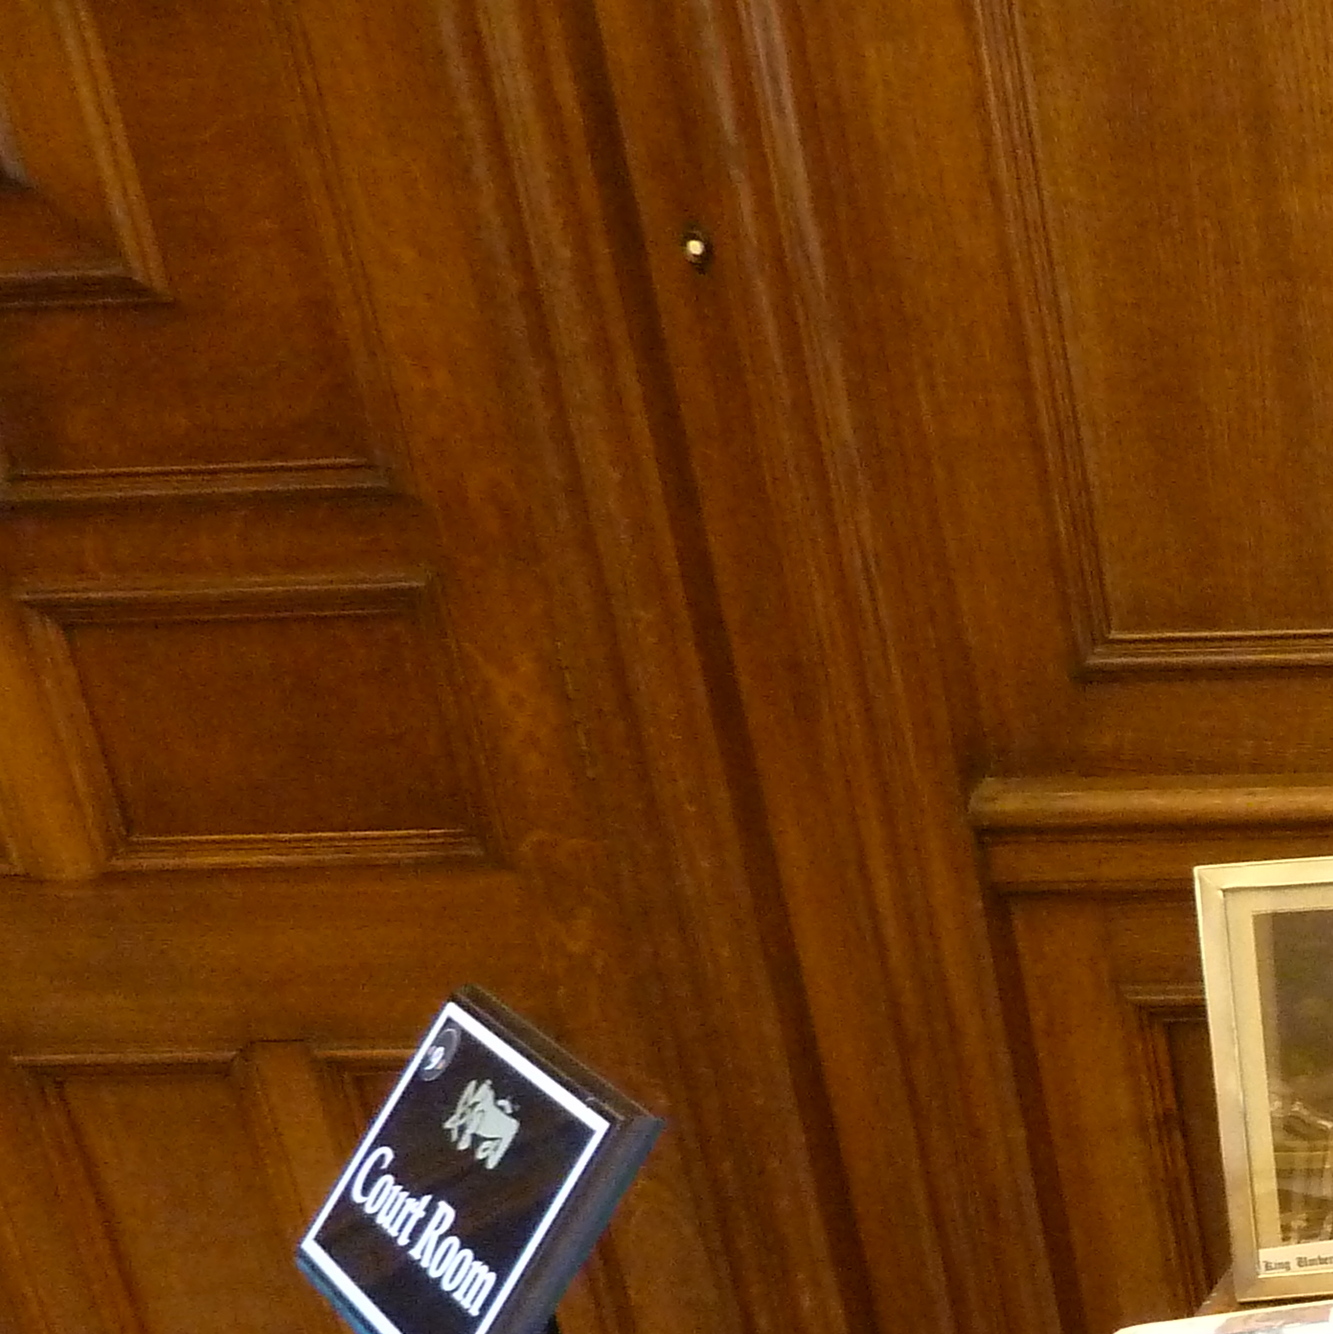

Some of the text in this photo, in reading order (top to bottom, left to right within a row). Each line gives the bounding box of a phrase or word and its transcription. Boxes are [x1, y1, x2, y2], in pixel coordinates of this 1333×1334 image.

[351, 1146, 498, 1317] Court Room
[1263, 1260, 1291, 1272] King
